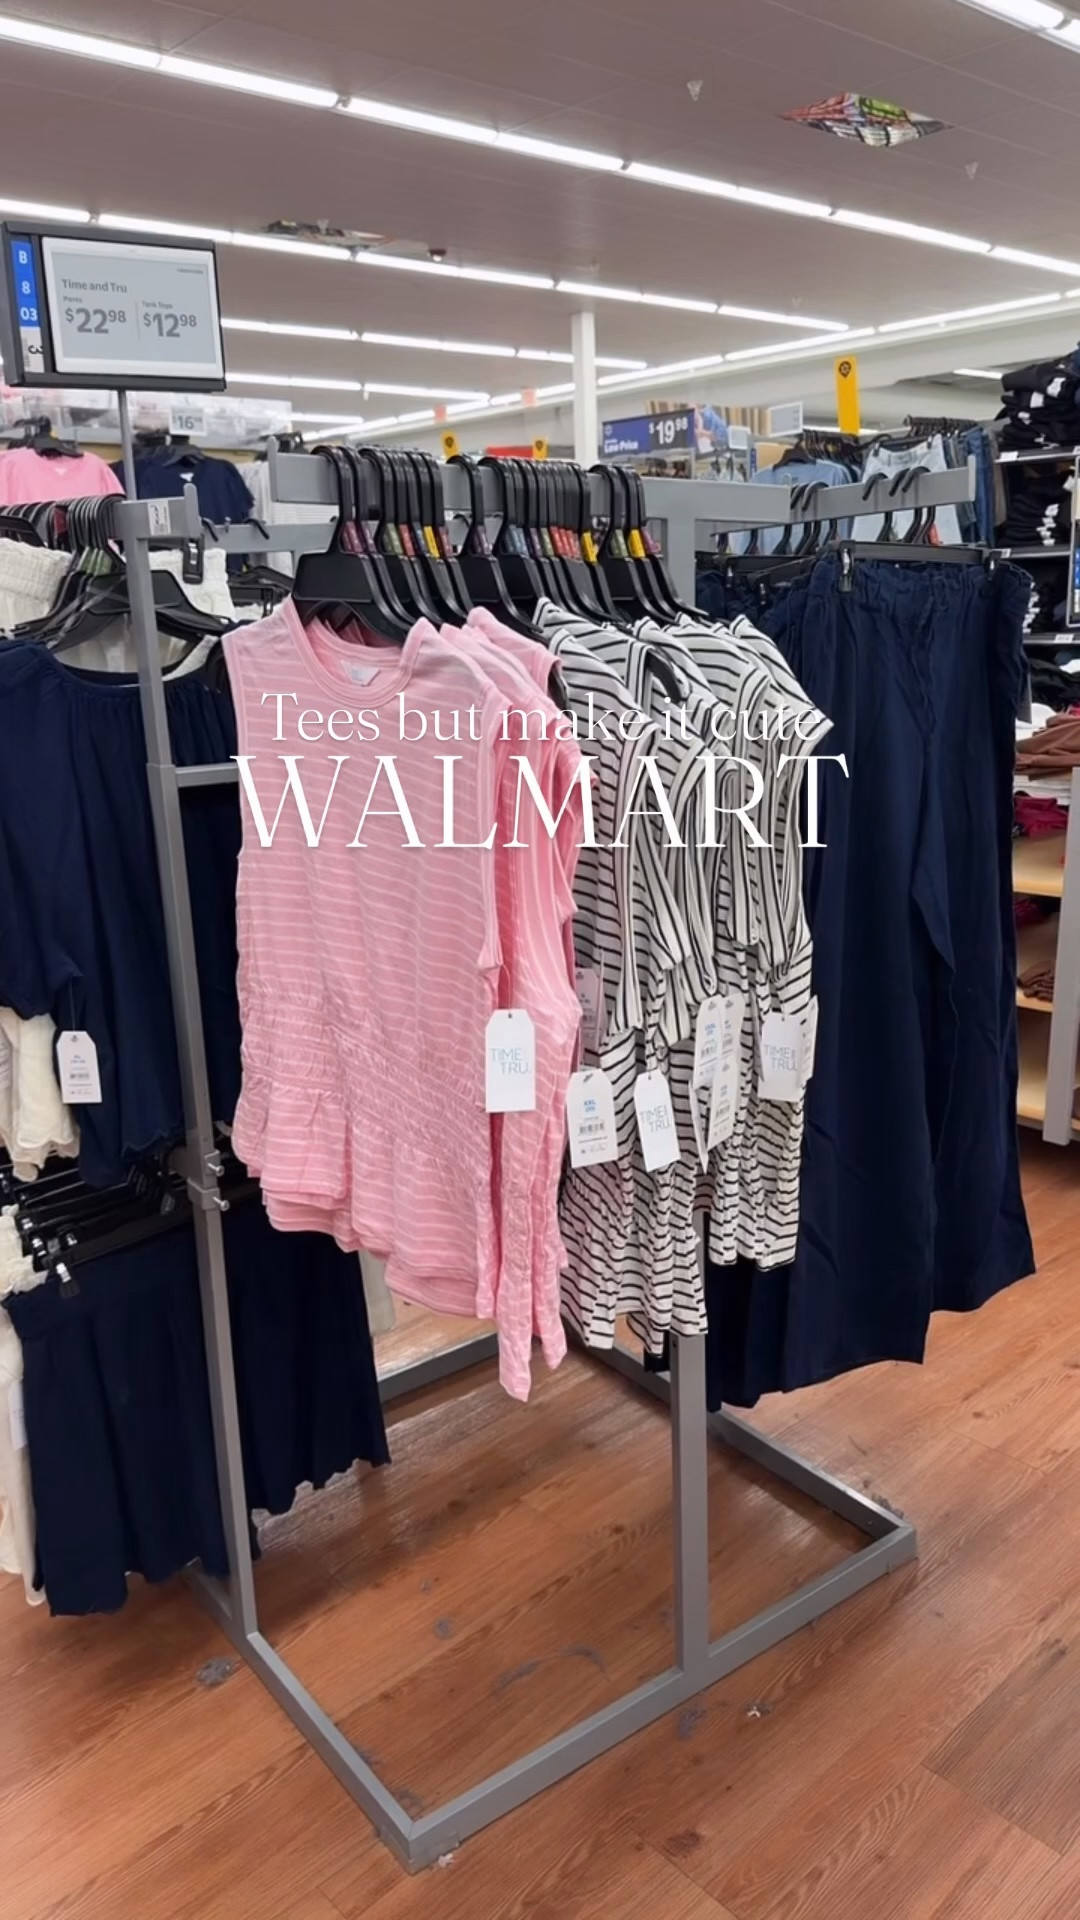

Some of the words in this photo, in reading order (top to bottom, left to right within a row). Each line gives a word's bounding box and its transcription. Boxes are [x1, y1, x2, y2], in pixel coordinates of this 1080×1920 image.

[18, 249, 28, 264] B
[21, 281, 31, 295] 8
[61, 278, 88, 290] Time
[89, 281, 109, 292] and
[110, 282, 127, 293] Tru
[20, 306, 38, 321] 03
